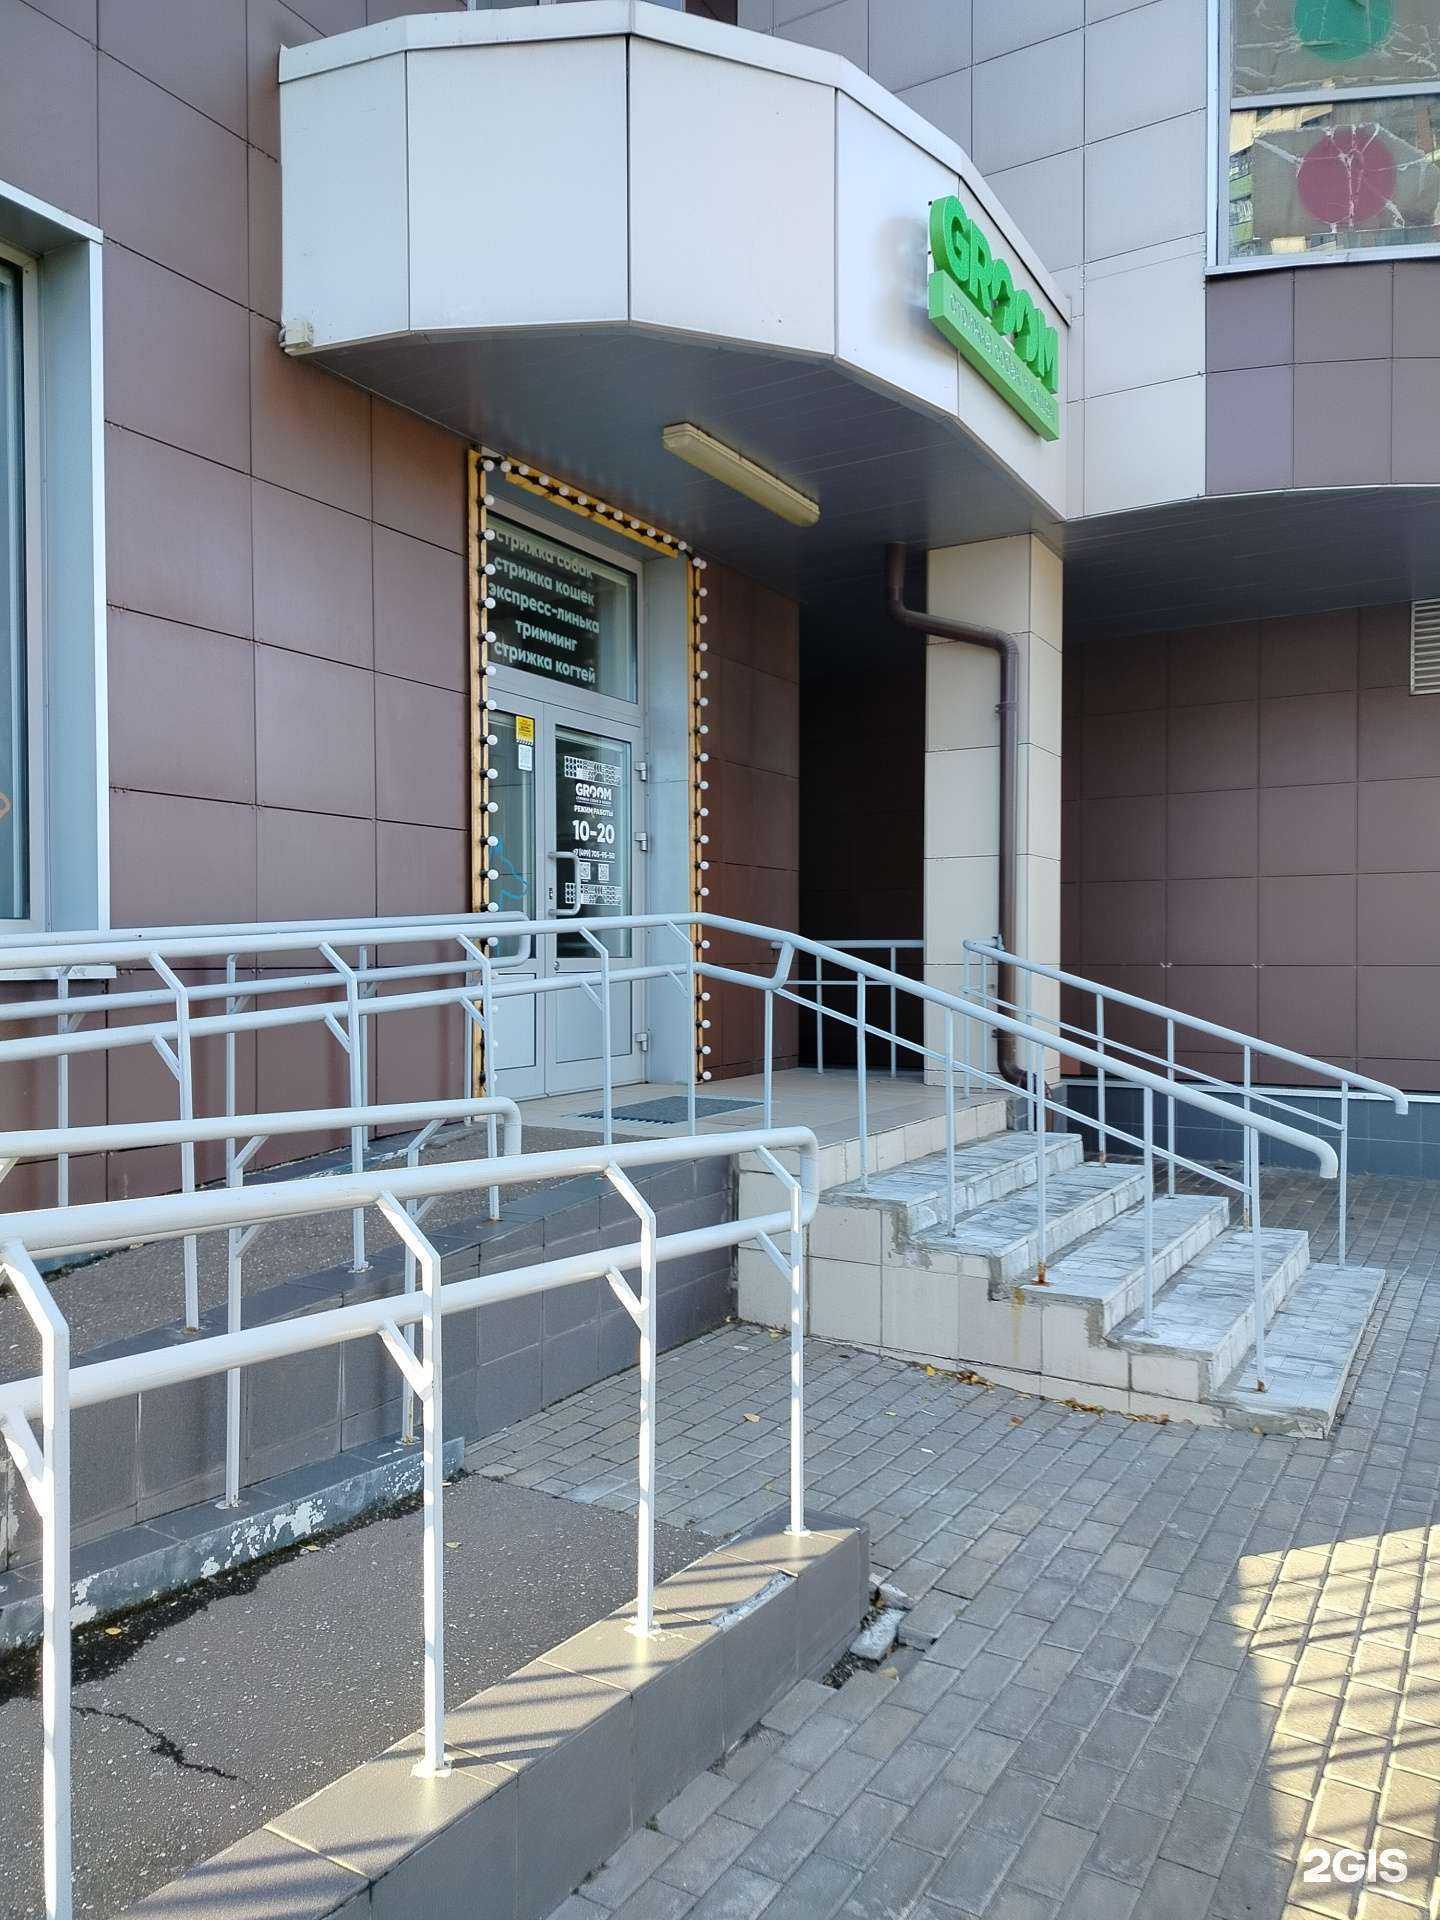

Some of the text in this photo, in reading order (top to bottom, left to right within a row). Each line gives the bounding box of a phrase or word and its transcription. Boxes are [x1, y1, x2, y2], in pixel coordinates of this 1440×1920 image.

[930, 195, 1058, 394] GROOM
[496, 529, 593, 579] стрижка собак
[494, 556, 595, 607] стрижка кошек
[488, 582, 600, 634] экспресс-линька
[515, 620, 578, 652] тримминг
[494, 641, 596, 684] стрижка когтей
[574, 804, 614, 817] РЕЖИМ РАБОТЫ
[576, 782, 612, 801] GROOM
[572, 819, 615, 844] 10-20
